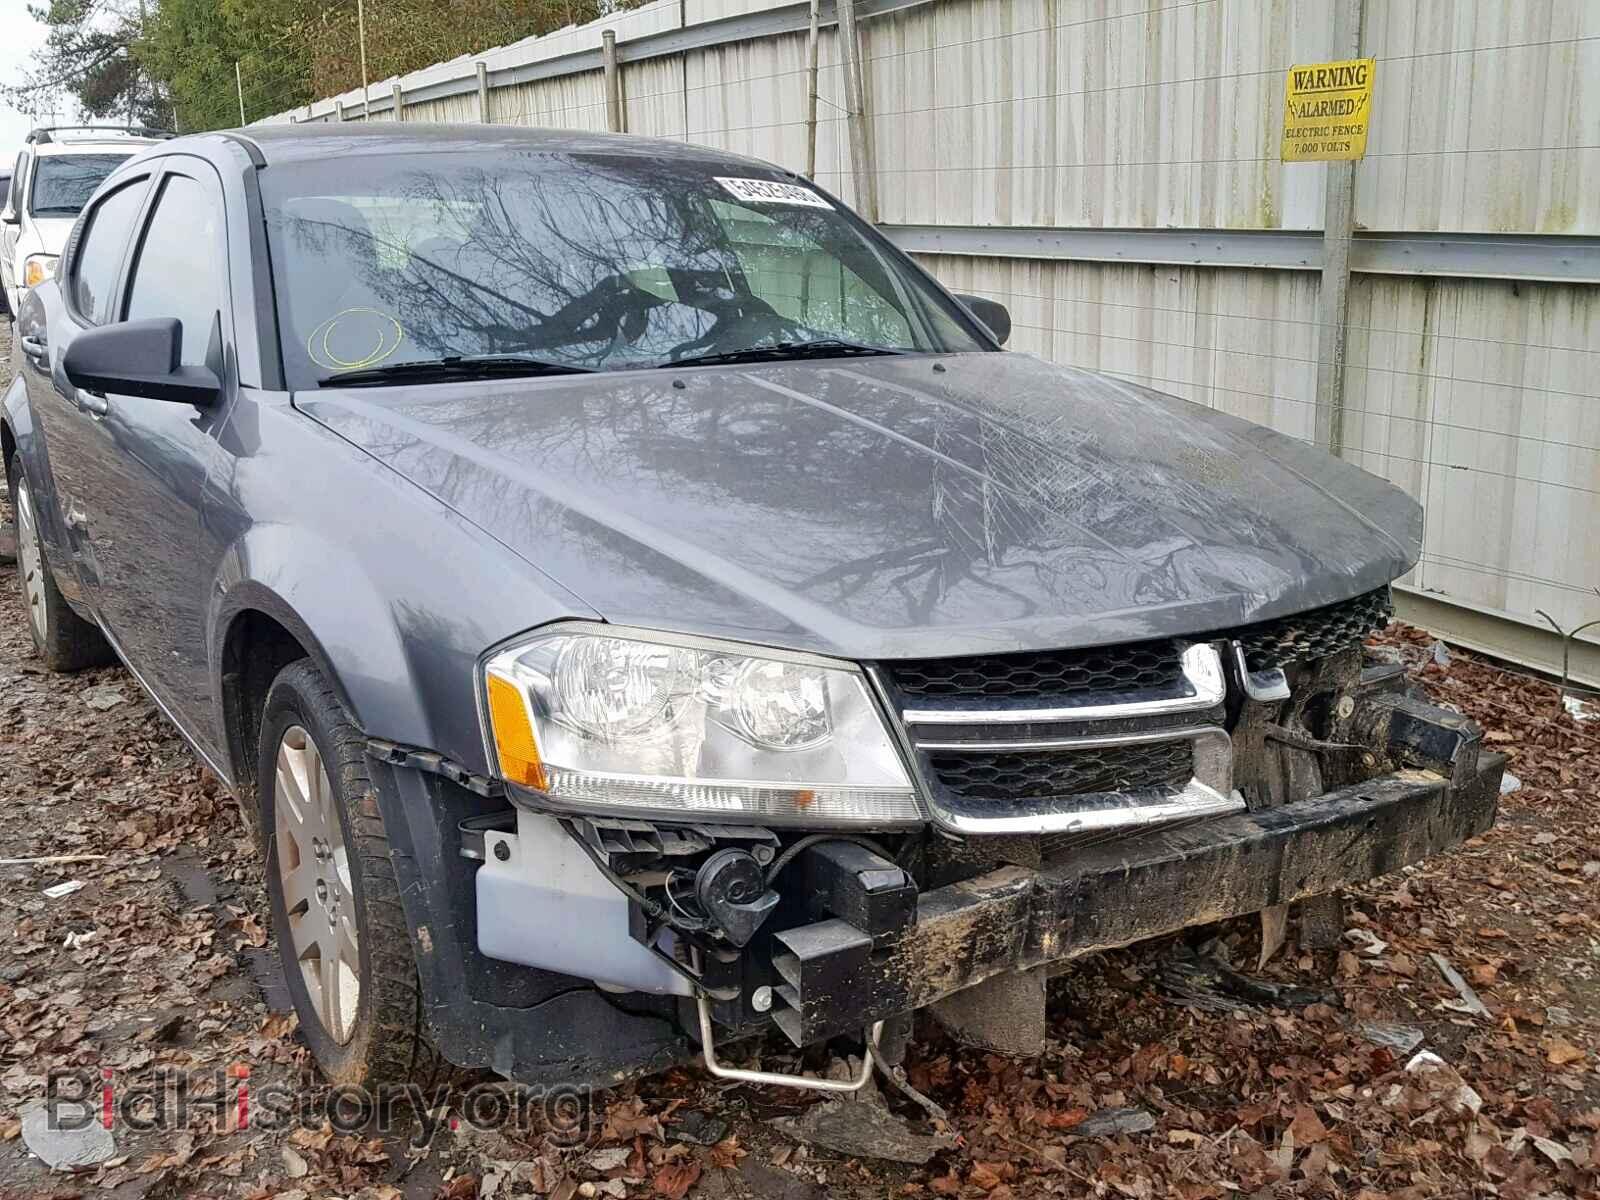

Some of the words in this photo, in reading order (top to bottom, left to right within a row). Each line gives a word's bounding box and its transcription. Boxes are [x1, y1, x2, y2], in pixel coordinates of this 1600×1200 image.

[1293, 65, 1367, 91] WARNING
[1298, 99, 1354, 118] ALARMED
[1286, 126, 1330, 138] ELECTRIC
[1332, 124, 1363, 136] FENCE
[1321, 141, 1351, 152] VOLTS
